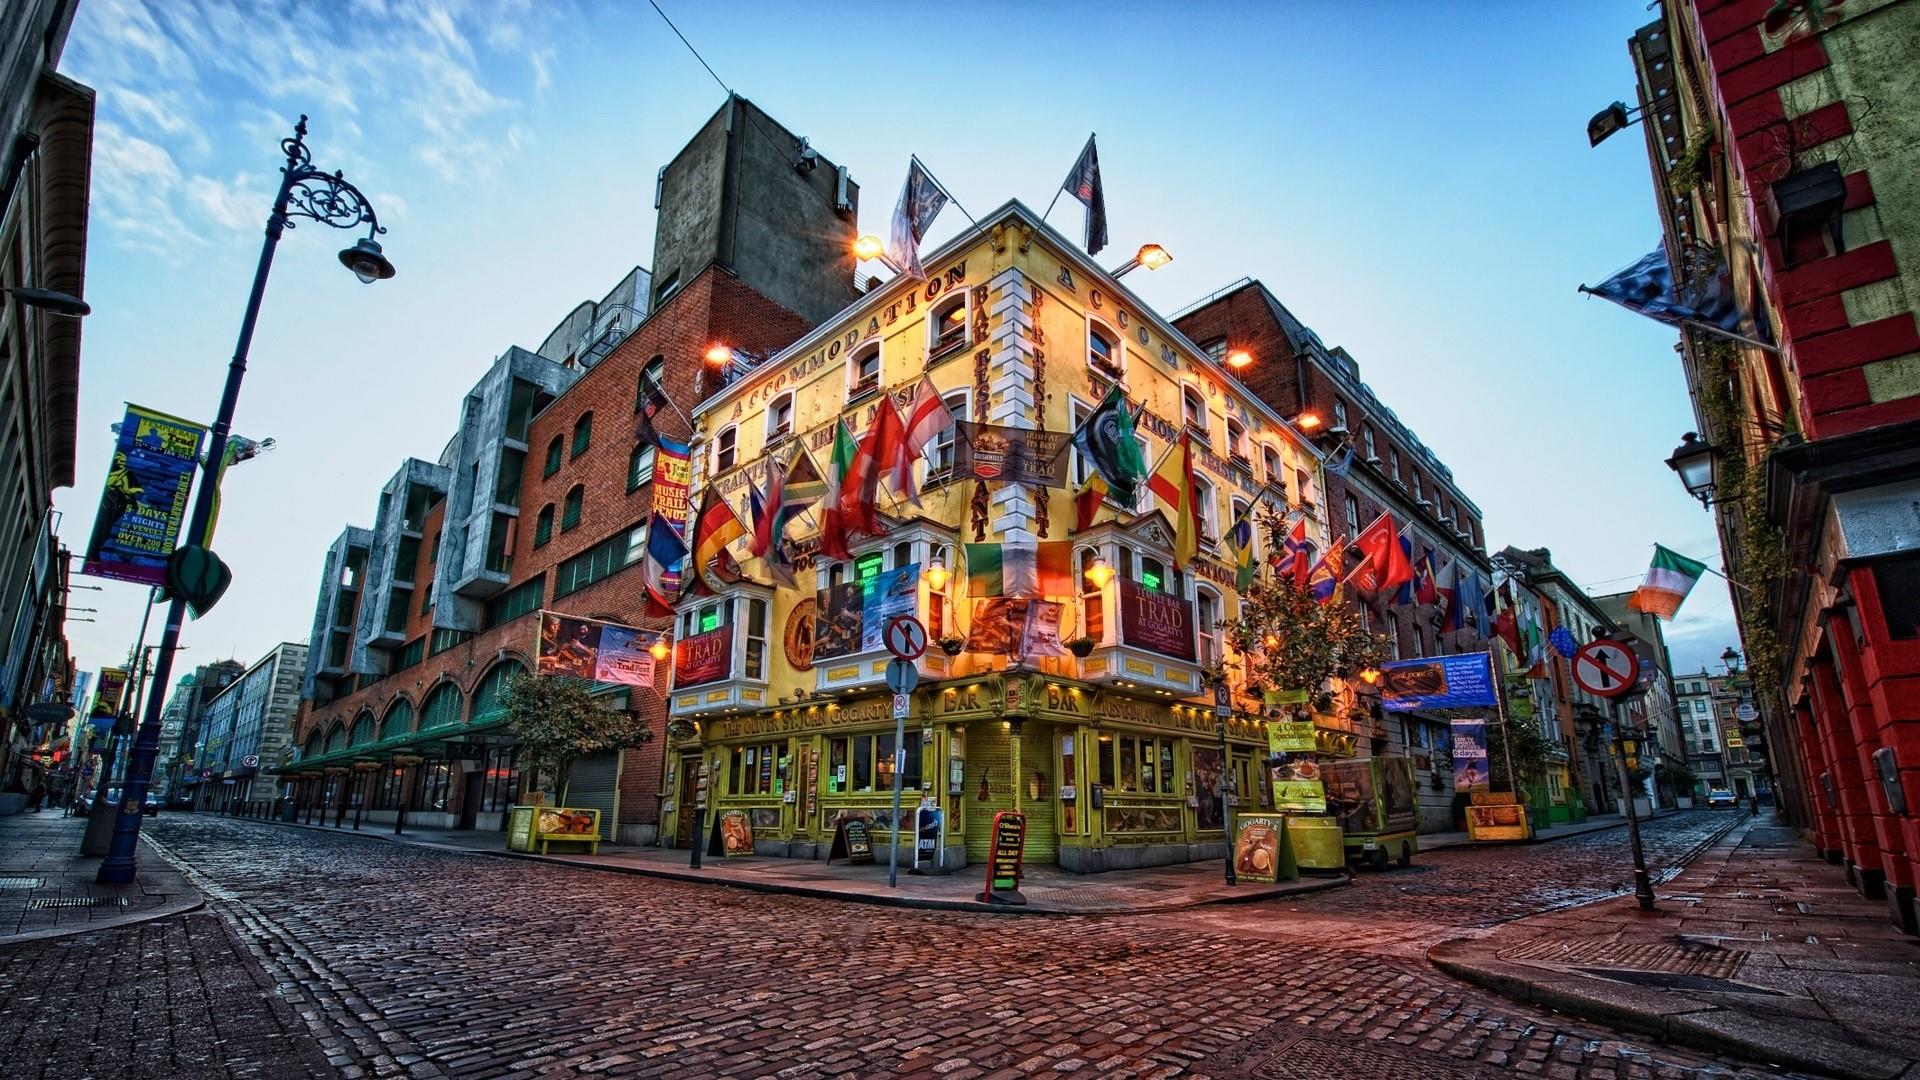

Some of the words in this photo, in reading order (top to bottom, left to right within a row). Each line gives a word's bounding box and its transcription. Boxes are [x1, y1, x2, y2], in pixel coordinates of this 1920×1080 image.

[972, 286, 992, 346] BAR
[1030, 285, 1046, 346] BAR
[730, 259, 968, 421] ACCOMMODATION
[811, 409, 858, 450] IRIH
[168, 432, 195, 447] Trad
[168, 440, 194, 456] Fest
[970, 348, 992, 543] RESTANT
[1032, 347, 1051, 539] RESTANT
[973, 452, 1004, 462] BUSHMILLS
[1023, 463, 1056, 475] TRAD
[654, 483, 686, 499] MUSIC
[653, 493, 687, 510] TRAIL
[126, 503, 133, 513] 5
[137, 505, 168, 520] DAYS
[122, 513, 129, 521] 5
[131, 515, 166, 529] NIGHTS
[132, 524, 164, 536] VENUES
[118, 532, 143, 543] OVER
[145, 539, 161, 547] 200
[1136, 586, 1165, 604] TEMPLE
[1167, 600, 1181, 609] BAR
[1136, 596, 1183, 629] TRAD
[1138, 617, 1146, 626] AT
[687, 634, 710, 648] TEMPLE
[711, 630, 722, 640] BAR
[686, 638, 722, 663] TRAD
[943, 692, 981, 713] BAR
[1047, 684, 1080, 713] BAR
[723, 720, 741, 738] THE
[742, 716, 780, 735] OLIVER
[801, 707, 826, 729] JOHN
[830, 702, 893, 725] GOGARTY
[1101, 699, 1161, 725] RESTAURANT
[1194, 713, 1226, 736] OLIVR
[1276, 724, 1283, 733] 4
[1284, 722, 1309, 731] Course
[1460, 749, 1480, 757] days.
[1239, 817, 1279, 831] GOGARTY'S
[918, 838, 935, 850] ATM
